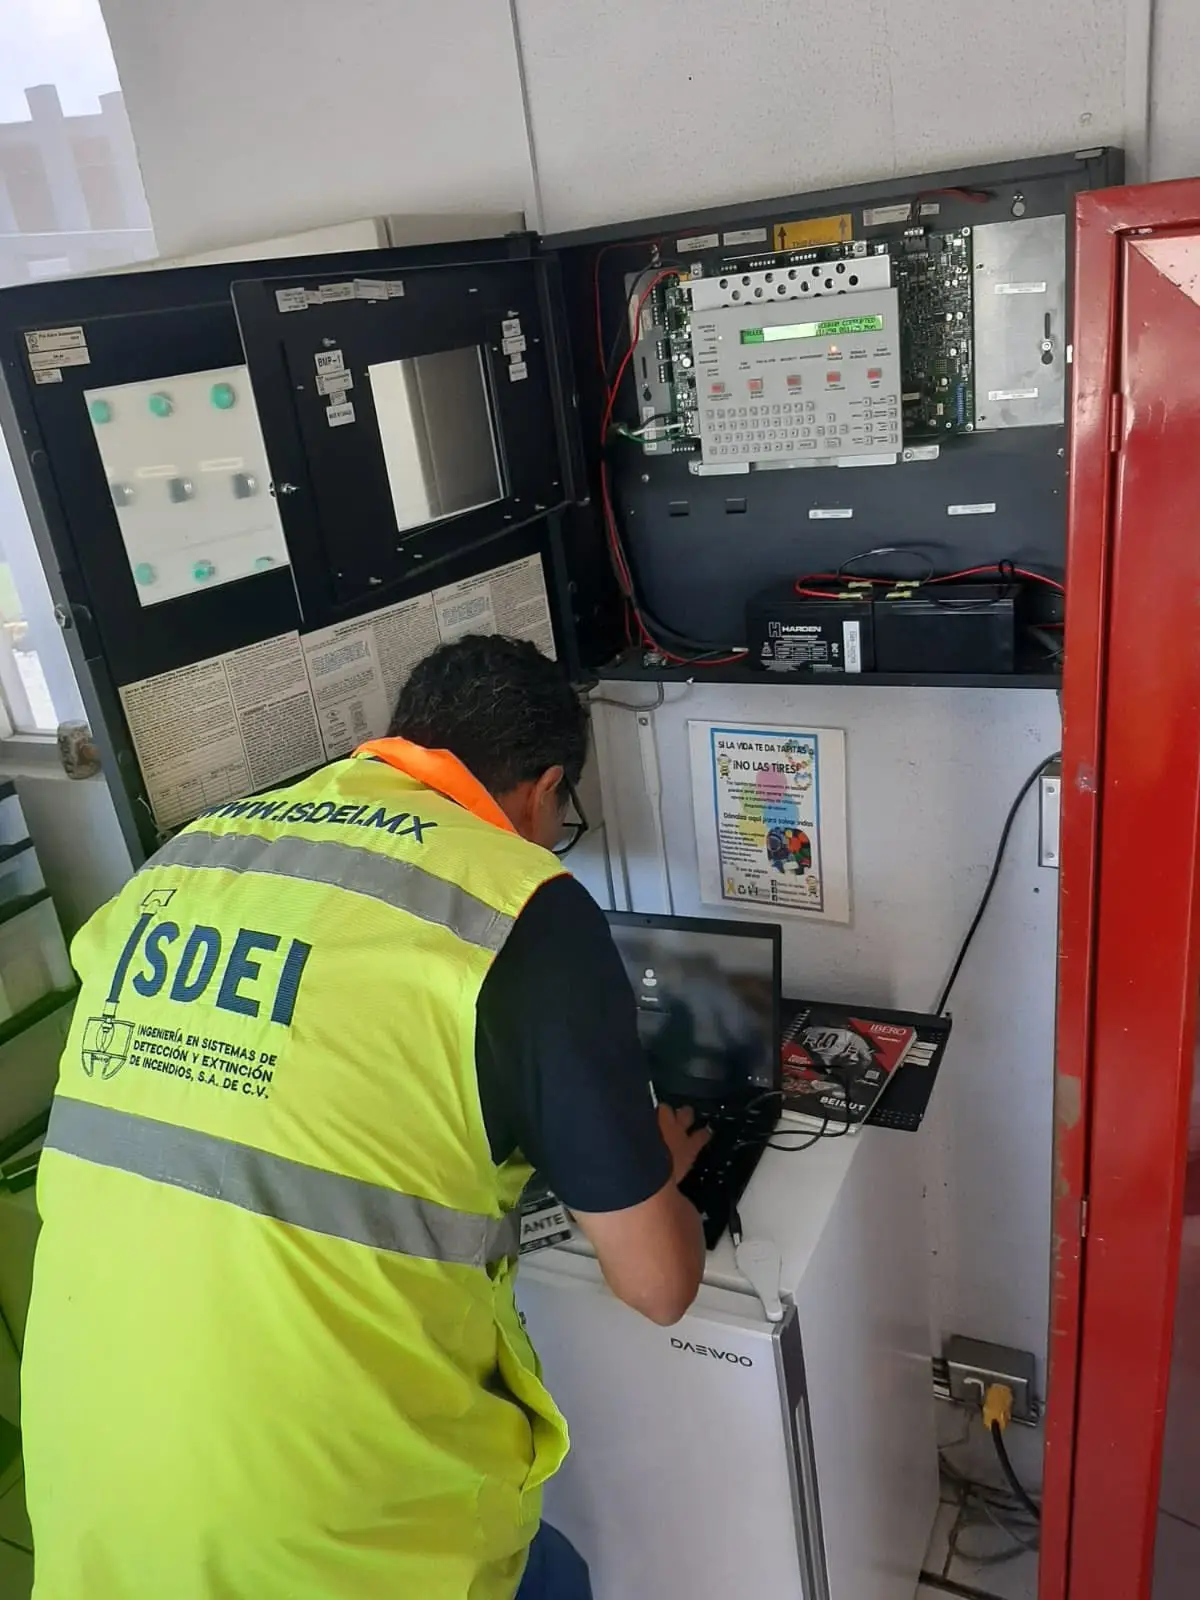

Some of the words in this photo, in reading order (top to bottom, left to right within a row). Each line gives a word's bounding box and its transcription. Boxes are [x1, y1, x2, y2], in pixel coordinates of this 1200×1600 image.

[737, 743, 753, 751] VIDA
[755, 744, 763, 752] TE
[765, 744, 775, 752] DA
[753, 762, 769, 772] LAS
[198, 801, 438, 844] WWW.ISDEI.MX
[109, 913, 312, 1027] ISDEI
[133, 1040, 189, 1062] DETECCIÓN
[192, 1052, 200, 1063] Y
[202, 1055, 273, 1082] EXTINCIÓN
[137, 1024, 182, 1044] INGENIERÍA
[186, 1035, 199, 1047] EN
[202, 1038, 256, 1061] SISTEMAS
[260, 1054, 278, 1066] DE
[129, 1054, 141, 1066] DE
[142, 1058, 194, 1082] INCENDIOS,
[198, 1071, 219, 1088] S.A.
[223, 1077, 239, 1090] DE
[242, 1082, 269, 1099] C.V.
[820, 1096, 866, 1112] BEIRUT
[670, 1337, 753, 1367] DAEWOO
